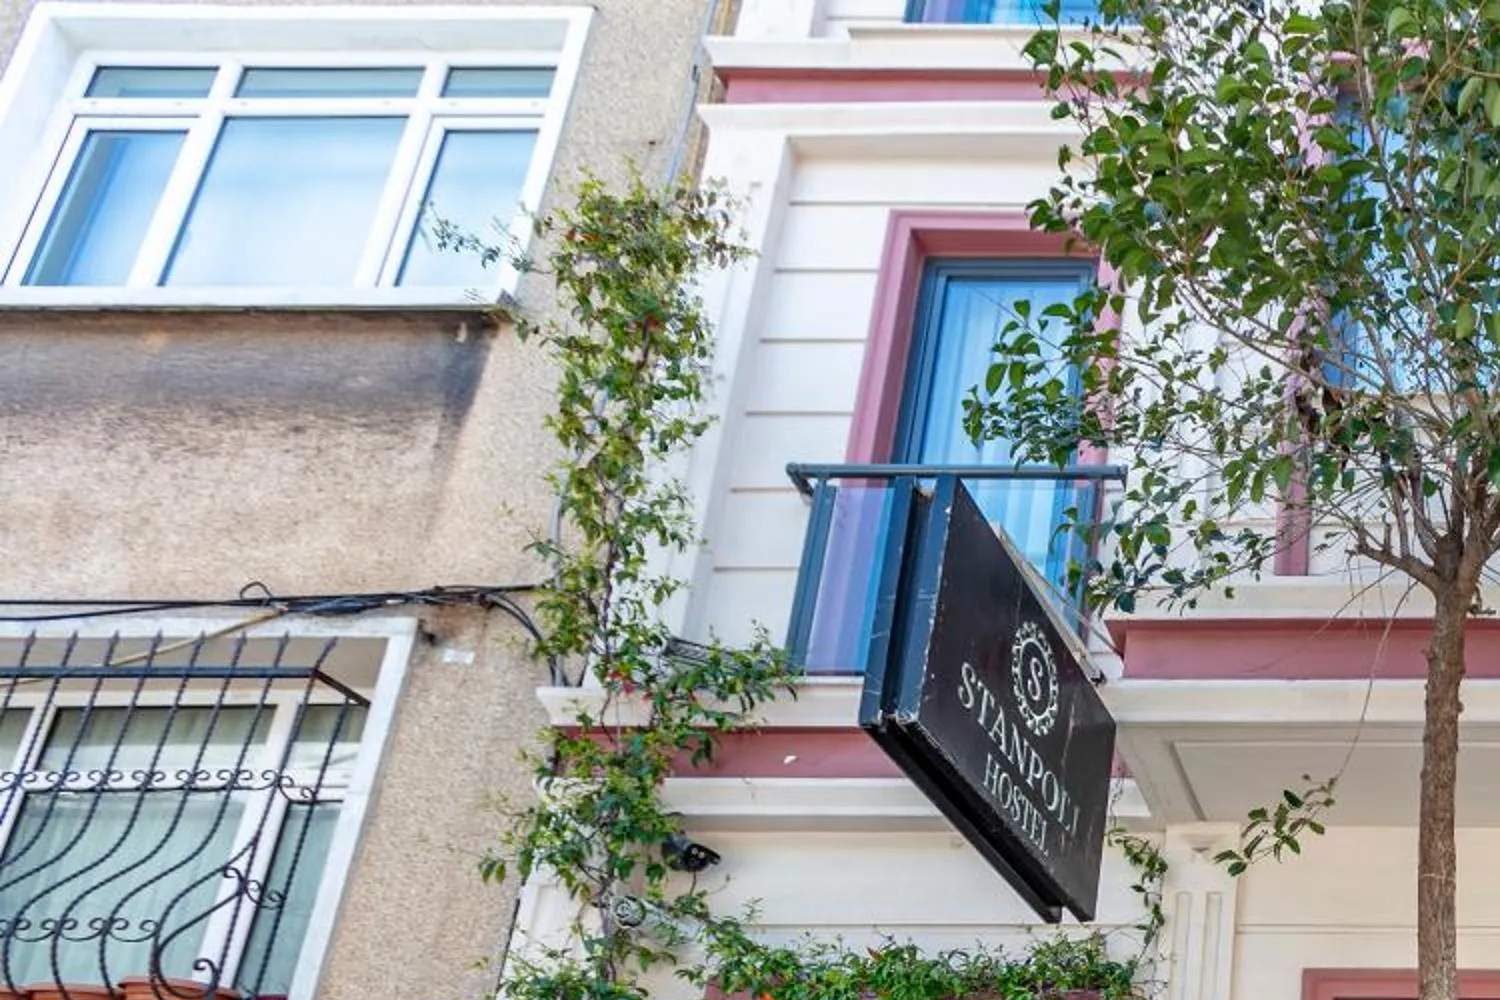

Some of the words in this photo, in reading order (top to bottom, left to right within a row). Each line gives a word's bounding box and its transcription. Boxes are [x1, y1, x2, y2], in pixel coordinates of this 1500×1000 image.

[1027, 657, 1044, 701] S
[957, 661, 1080, 837] STANPOLI
[983, 751, 1050, 857] HOSTEL
